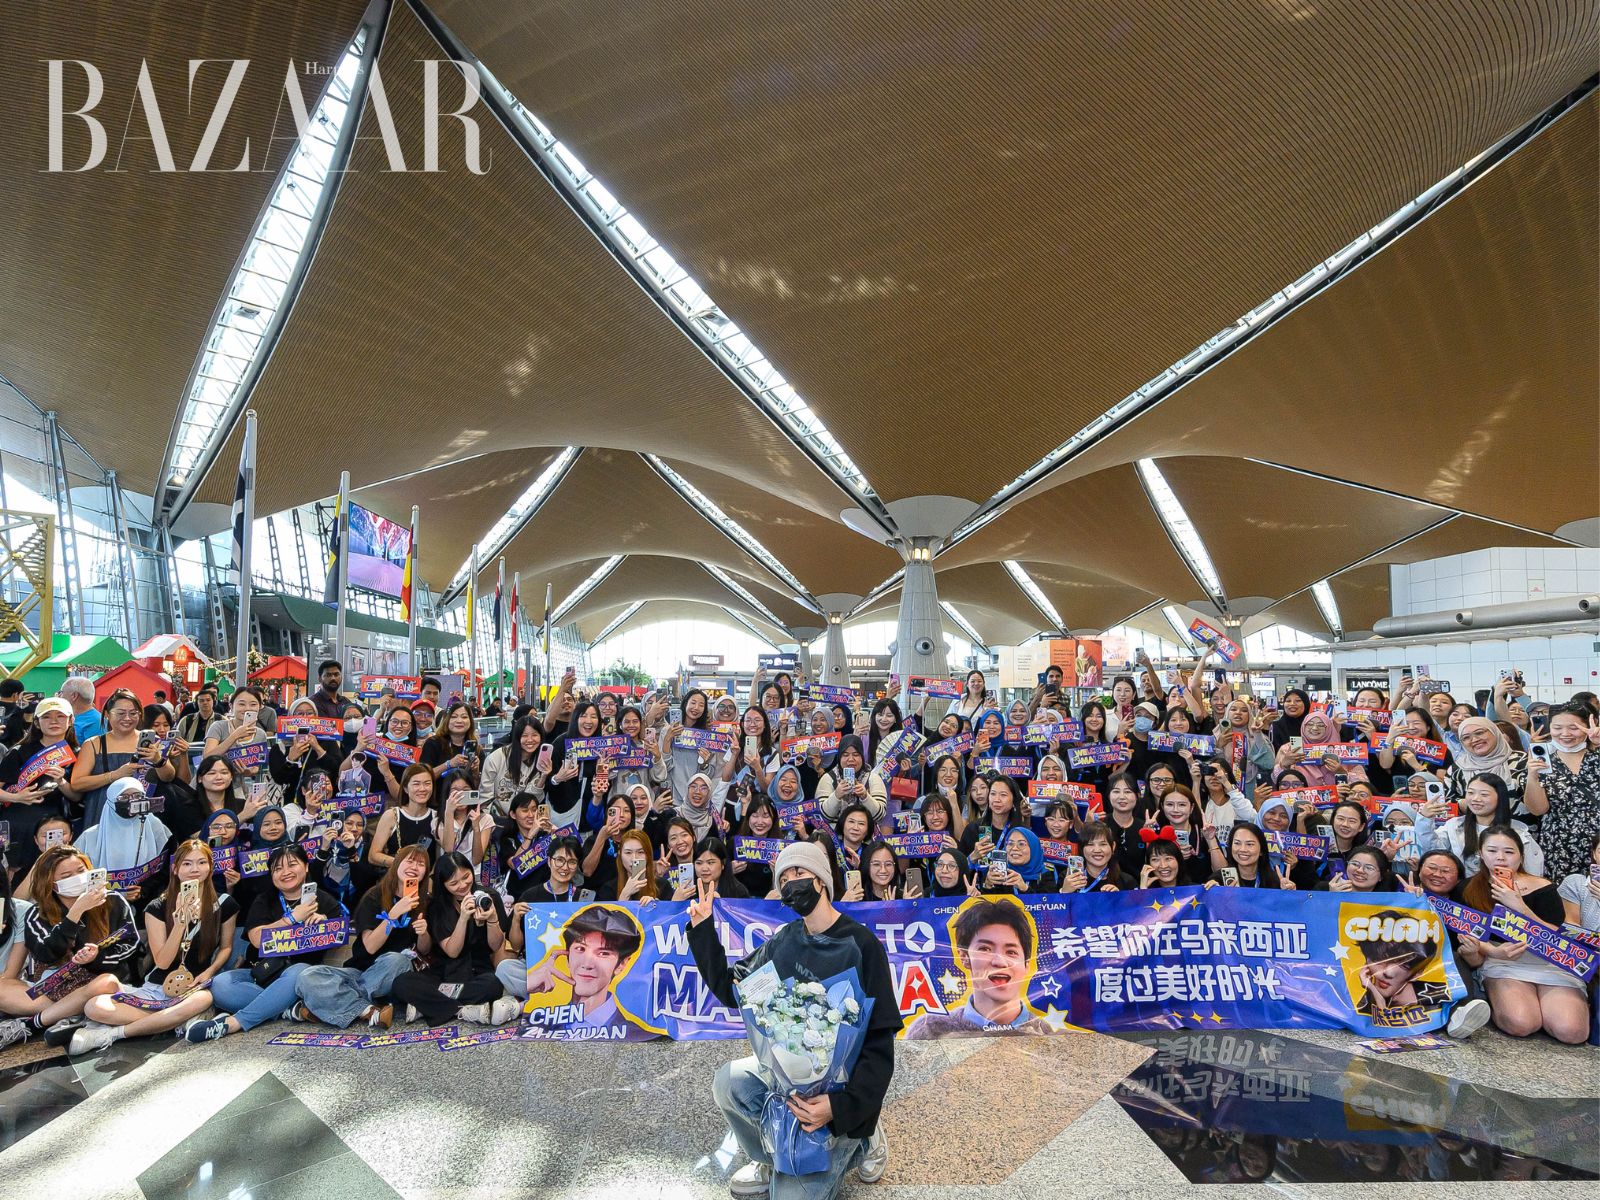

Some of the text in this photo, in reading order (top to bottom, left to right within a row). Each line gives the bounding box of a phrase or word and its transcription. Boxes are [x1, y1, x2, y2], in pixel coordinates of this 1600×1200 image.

[571, 739, 612, 749] WELCOME
[933, 903, 1067, 915] CHEN ZHEYUAN
[271, 924, 326, 941] WELCOME
[875, 921, 936, 954] TO
[1050, 919, 1310, 959] 希望你在马来西亚
[1344, 916, 1441, 944] CHAM
[1503, 911, 1567, 951] WELCOME
[276, 933, 337, 953] MALAYSIA
[1095, 963, 1285, 1004] 度过美好时光
[529, 1003, 584, 1025] CHEN
[521, 1023, 627, 1041] ZHEYUAN
